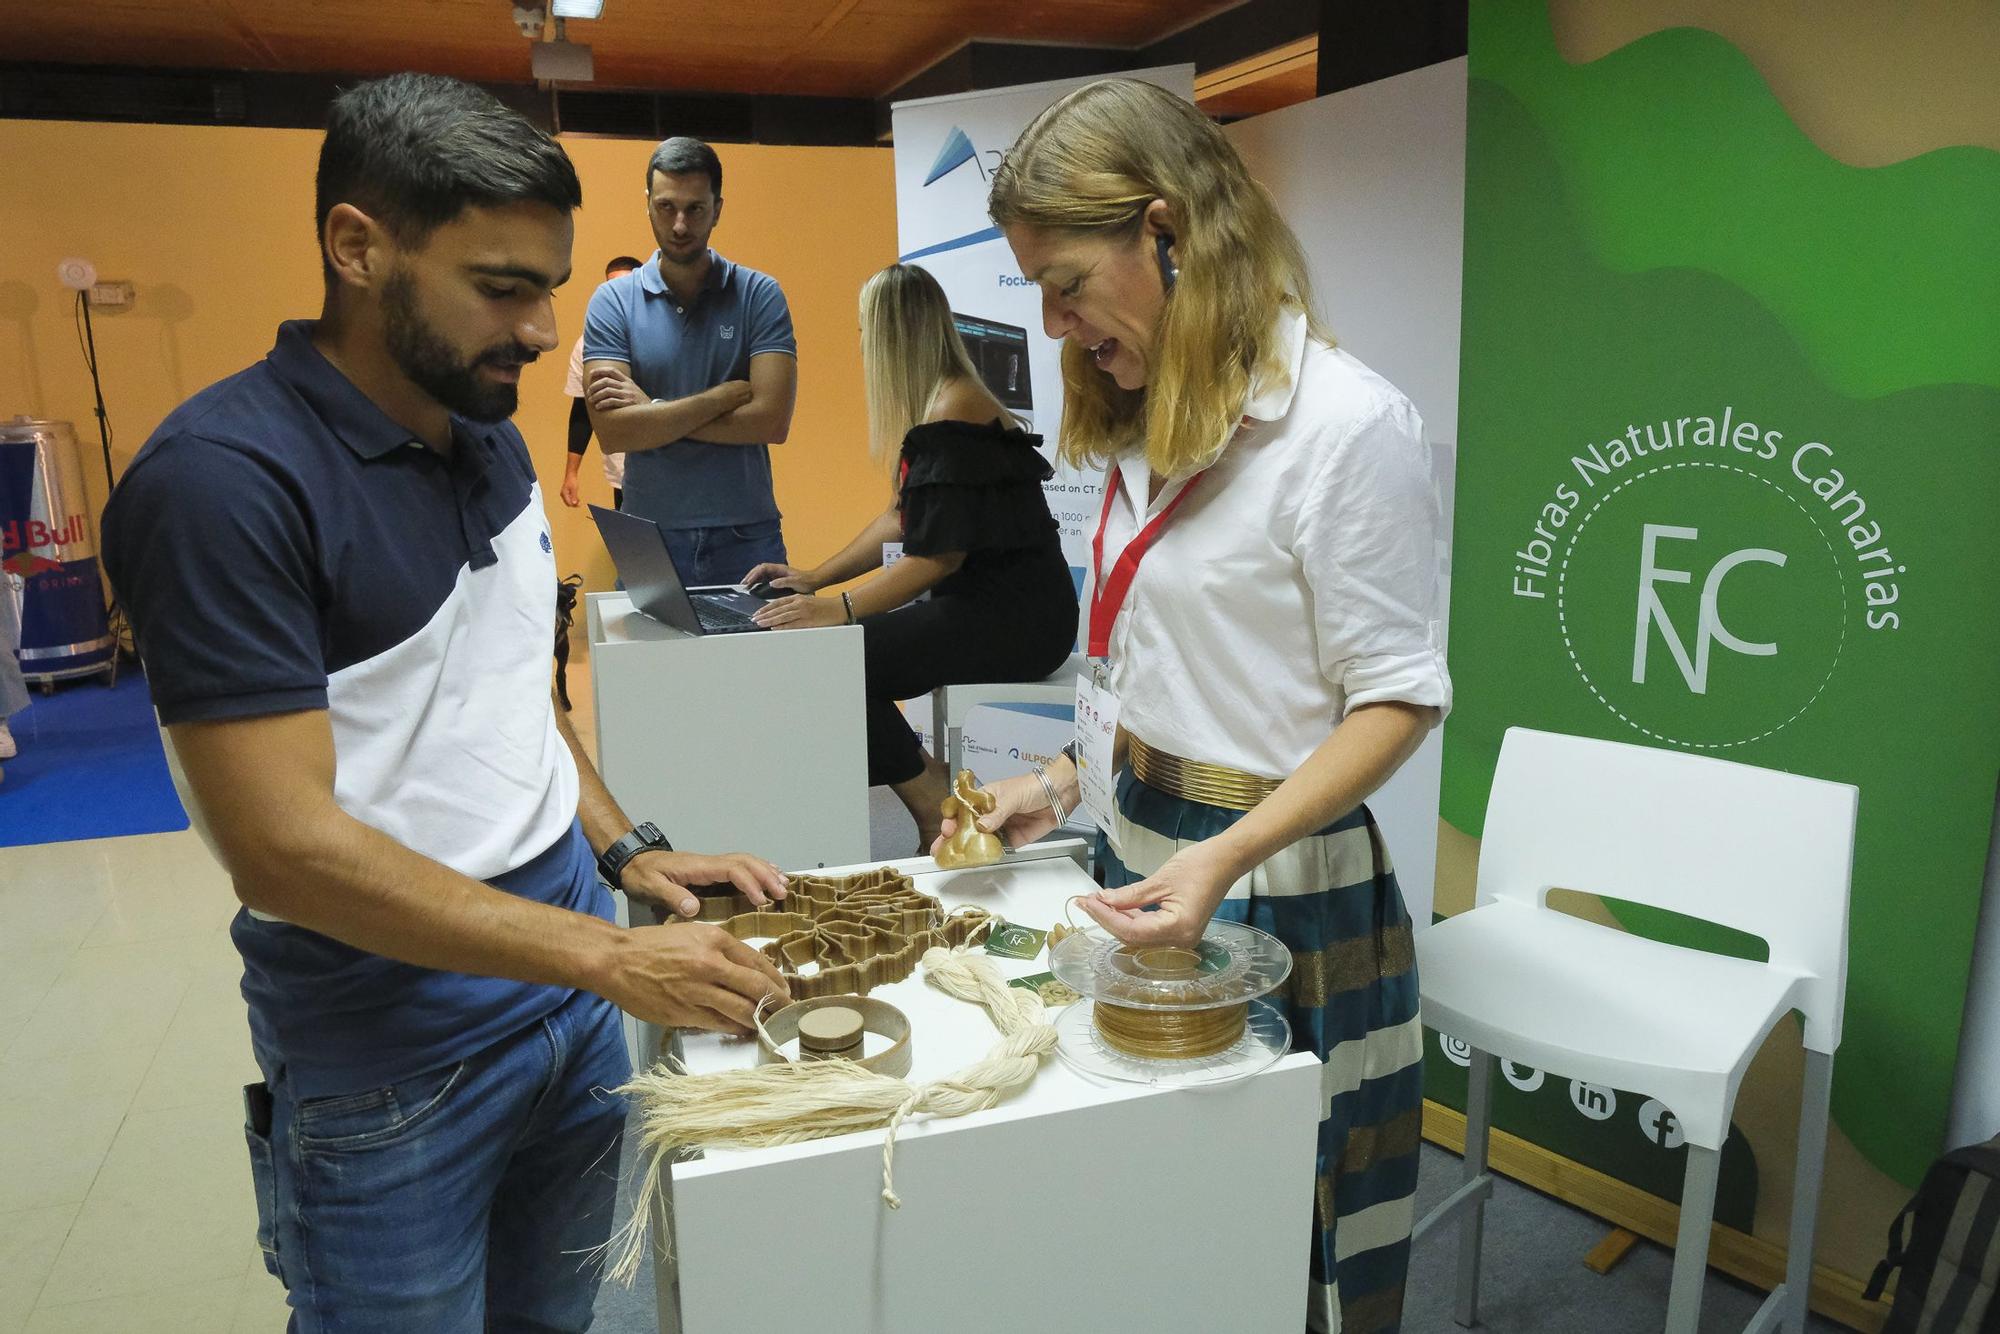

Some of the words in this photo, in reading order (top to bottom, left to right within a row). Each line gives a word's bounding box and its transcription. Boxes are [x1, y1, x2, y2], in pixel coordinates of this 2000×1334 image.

[1068, 485, 1080, 493] on
[1083, 485, 1096, 494] CT
[1060, 512, 1083, 522] 1000
[1513, 483, 1580, 599] Fibras
[1571, 406, 1784, 487] Naturales
[1791, 441, 1907, 631] Canarias
[25, 514, 84, 548] Bull
